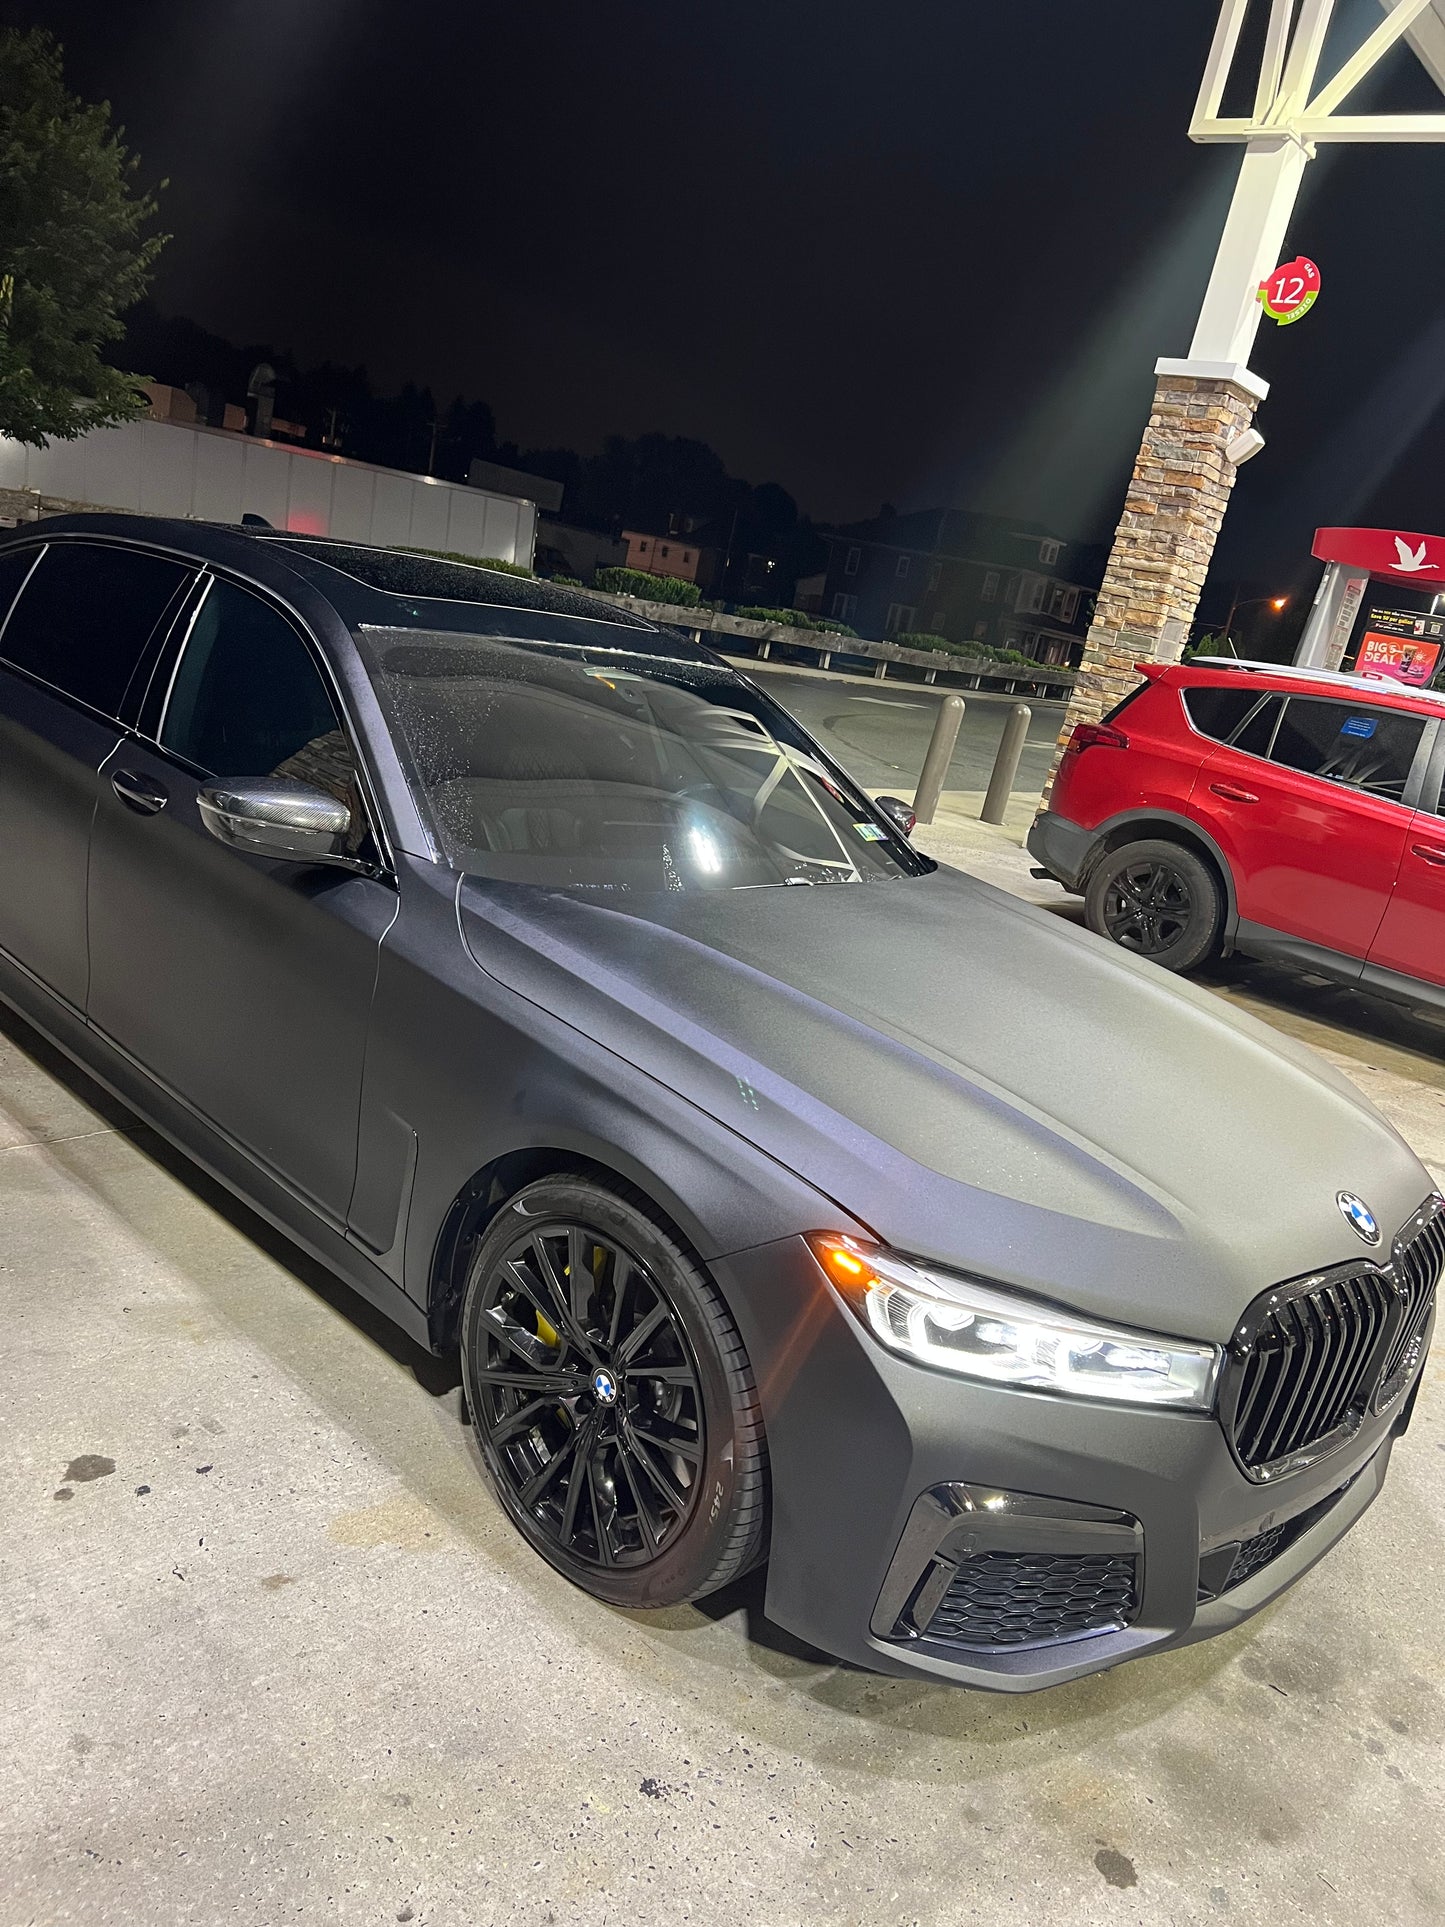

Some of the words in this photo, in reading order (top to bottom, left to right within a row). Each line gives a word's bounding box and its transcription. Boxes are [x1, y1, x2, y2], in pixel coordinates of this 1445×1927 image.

[1304, 263, 1315, 279] GAS
[1270, 277, 1305, 304] 12
[1285, 297, 1312, 320] DIESEL
[1367, 641, 1388, 653] BIG
[1364, 651, 1396, 665] DEAL
